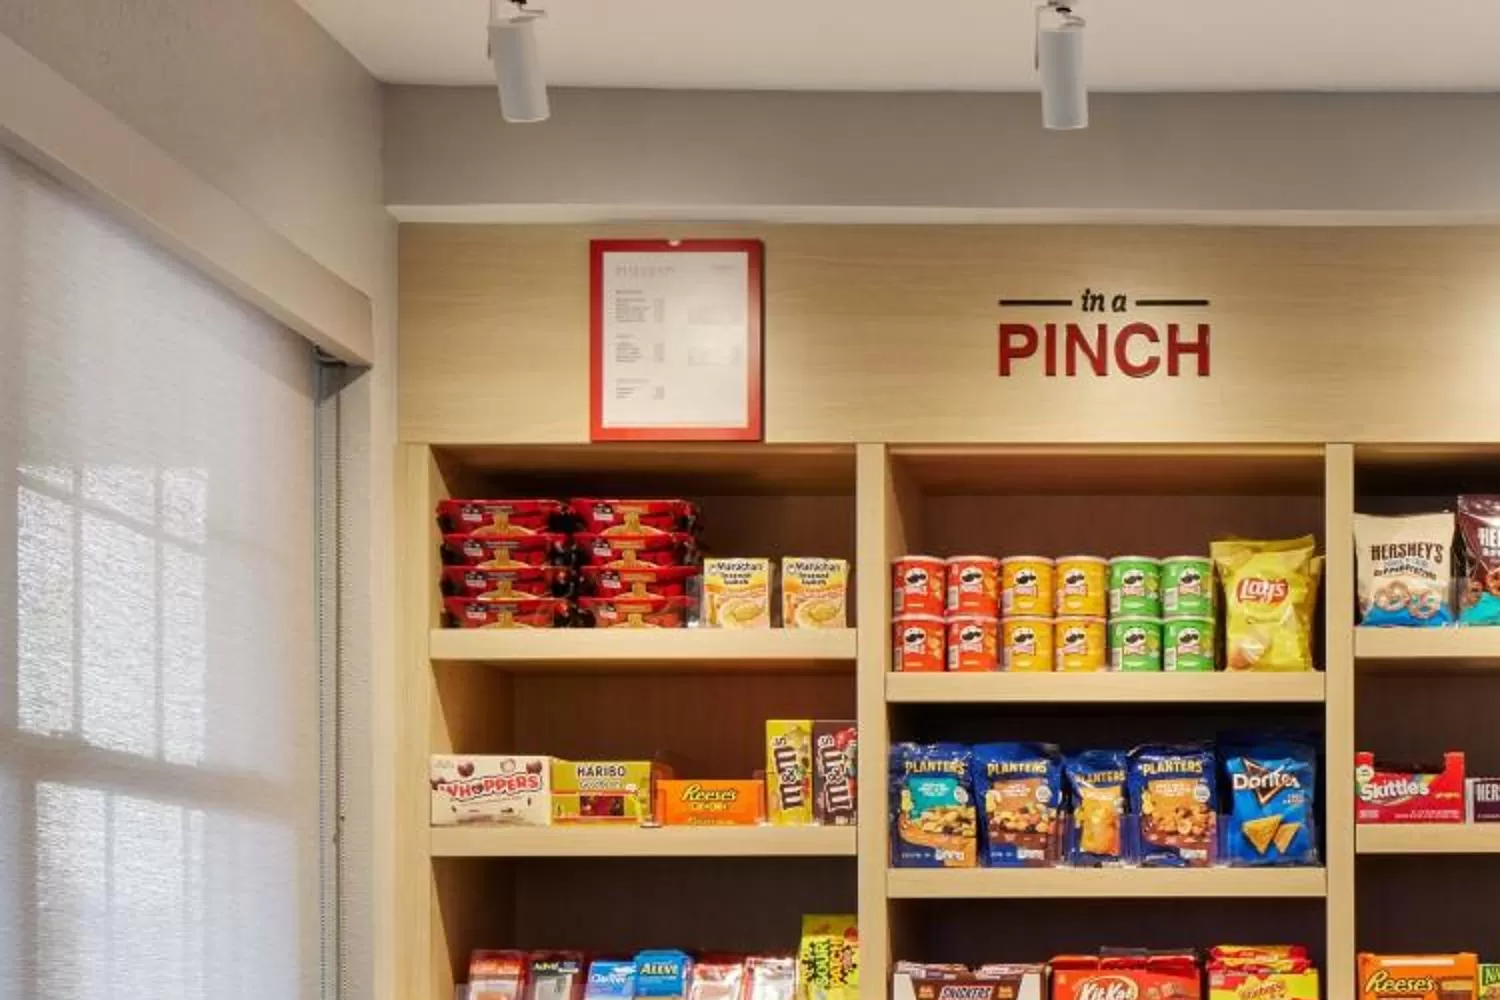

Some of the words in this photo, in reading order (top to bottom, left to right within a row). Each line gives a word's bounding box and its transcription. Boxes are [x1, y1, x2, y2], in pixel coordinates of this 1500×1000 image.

[1081, 288, 1105, 312] in
[1111, 292, 1127, 312] a
[998, 321, 1210, 378] PINCH
[1370, 542, 1444, 564] HERSHEY'S
[1239, 578, 1288, 602] Lay's
[577, 764, 626, 777] HARIBO
[904, 759, 966, 775] PLANTERS
[987, 759, 1048, 775] PLANTERS
[1143, 758, 1203, 777] PLANTERS
[445, 773, 540, 799] WHOPPERS
[1360, 776, 1430, 802] Skittles
[1366, 969, 1436, 993] Reese's
